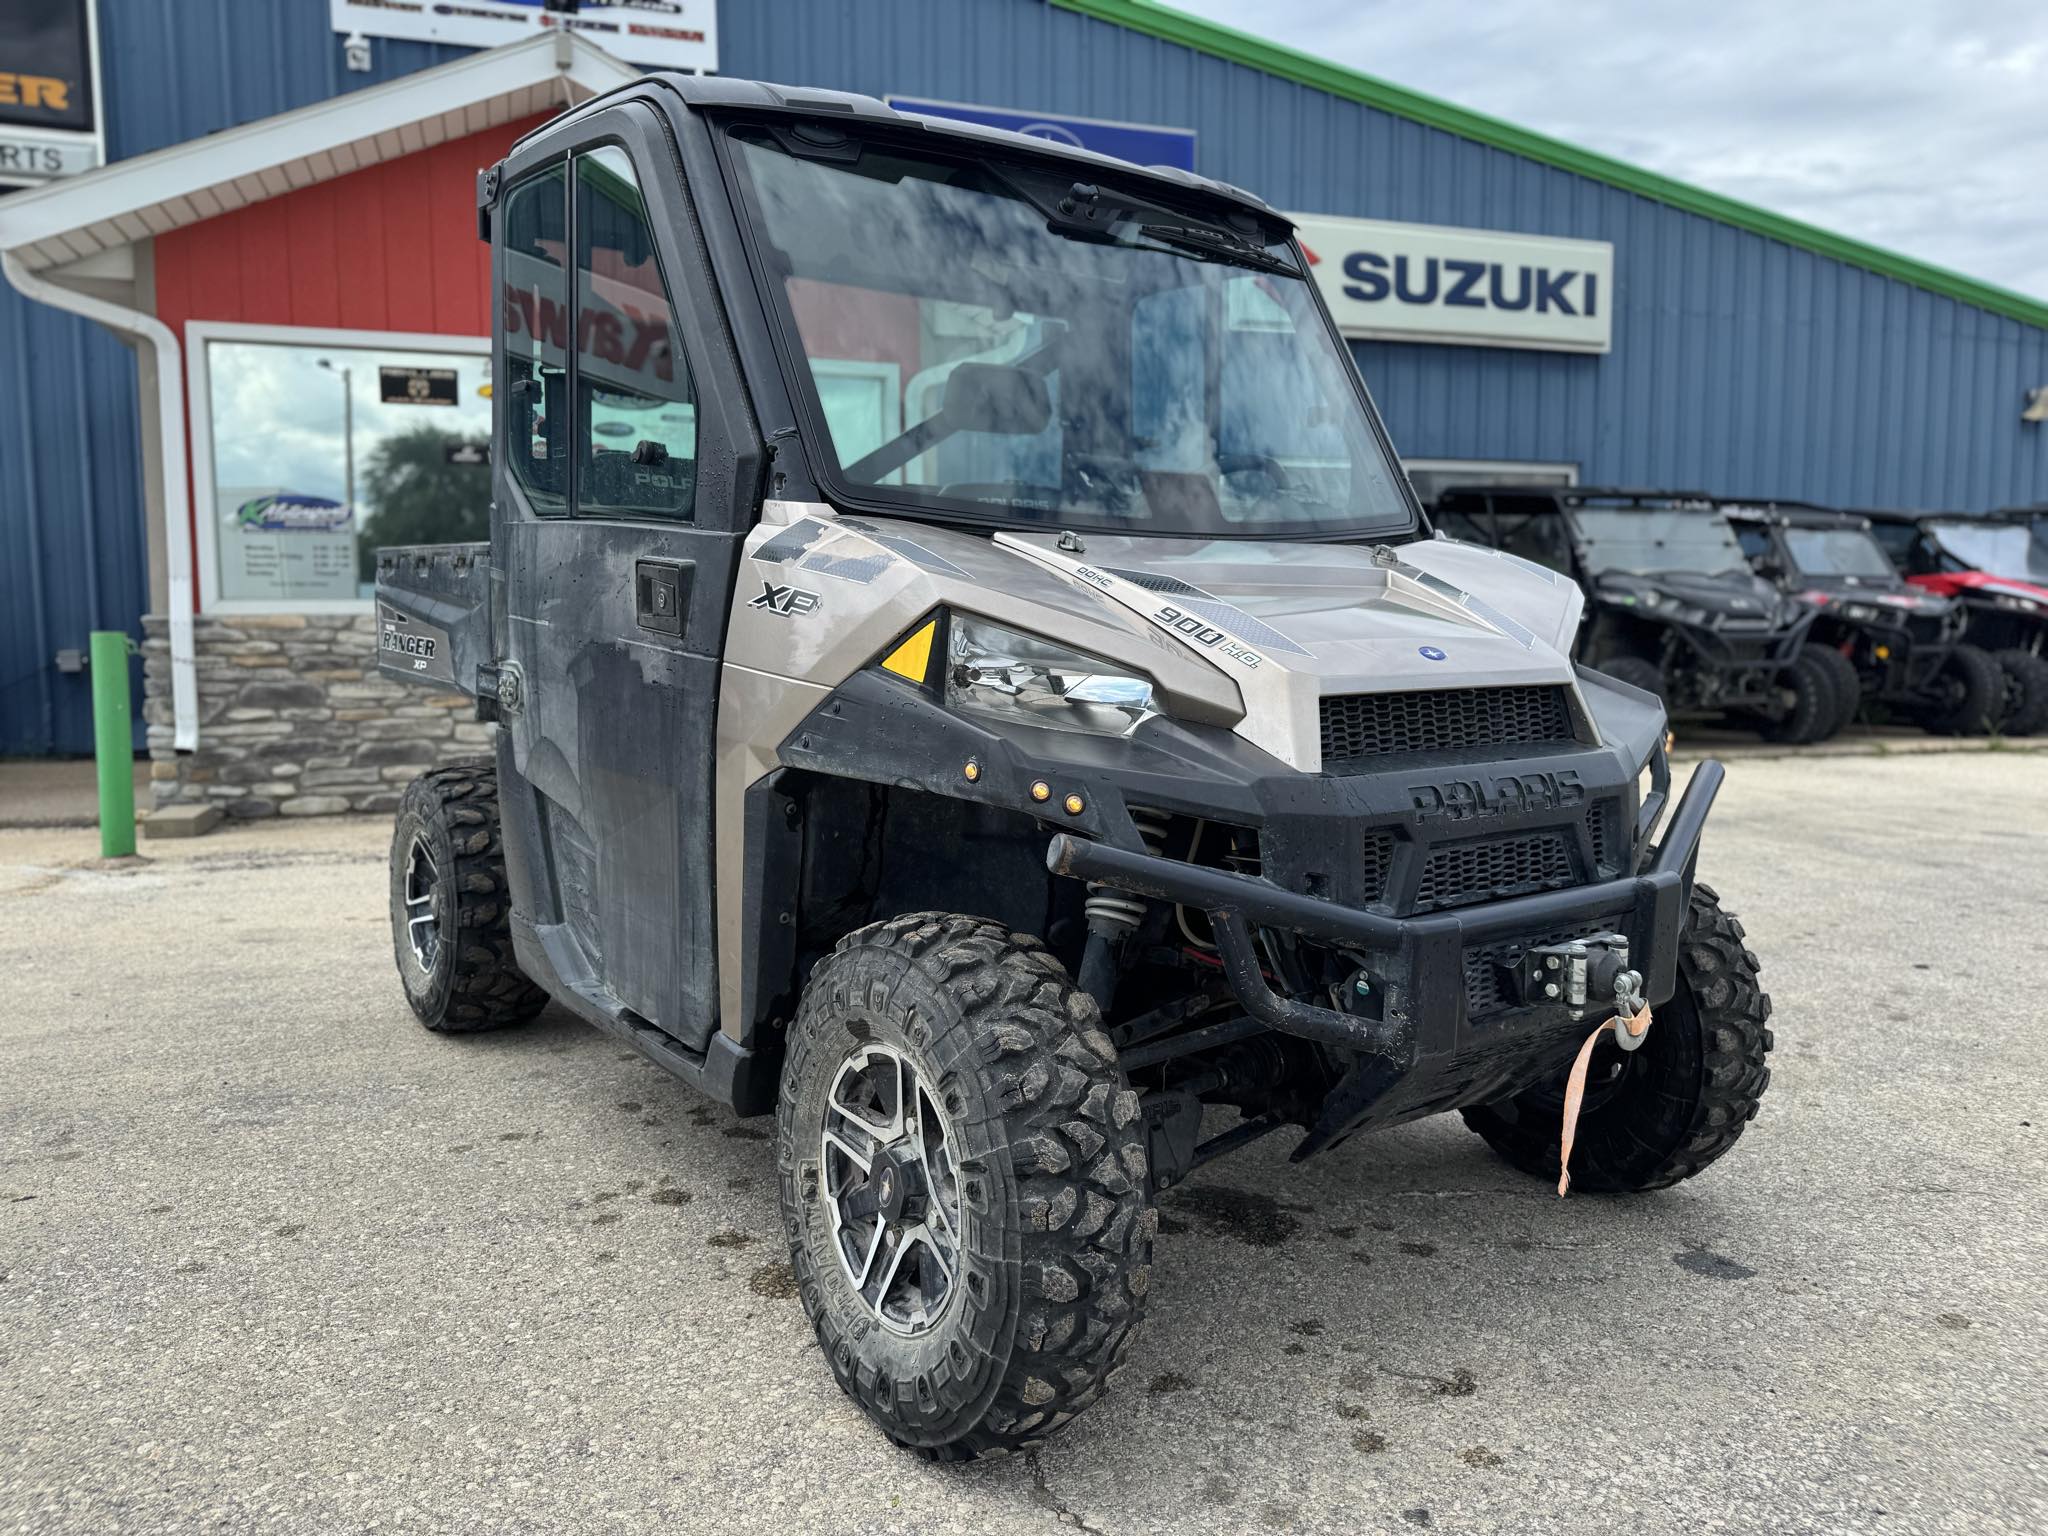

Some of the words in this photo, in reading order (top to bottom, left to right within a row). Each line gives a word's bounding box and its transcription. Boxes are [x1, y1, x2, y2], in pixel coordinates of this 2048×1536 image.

[1342, 252, 1598, 318] SUZUKI
[1076, 566, 1113, 588] DOHC
[746, 580, 821, 618] XP
[381, 630, 436, 660] RANGER
[1154, 606, 1227, 647] 900
[413, 659, 428, 671] XP
[1408, 770, 1585, 825] POLARIS
